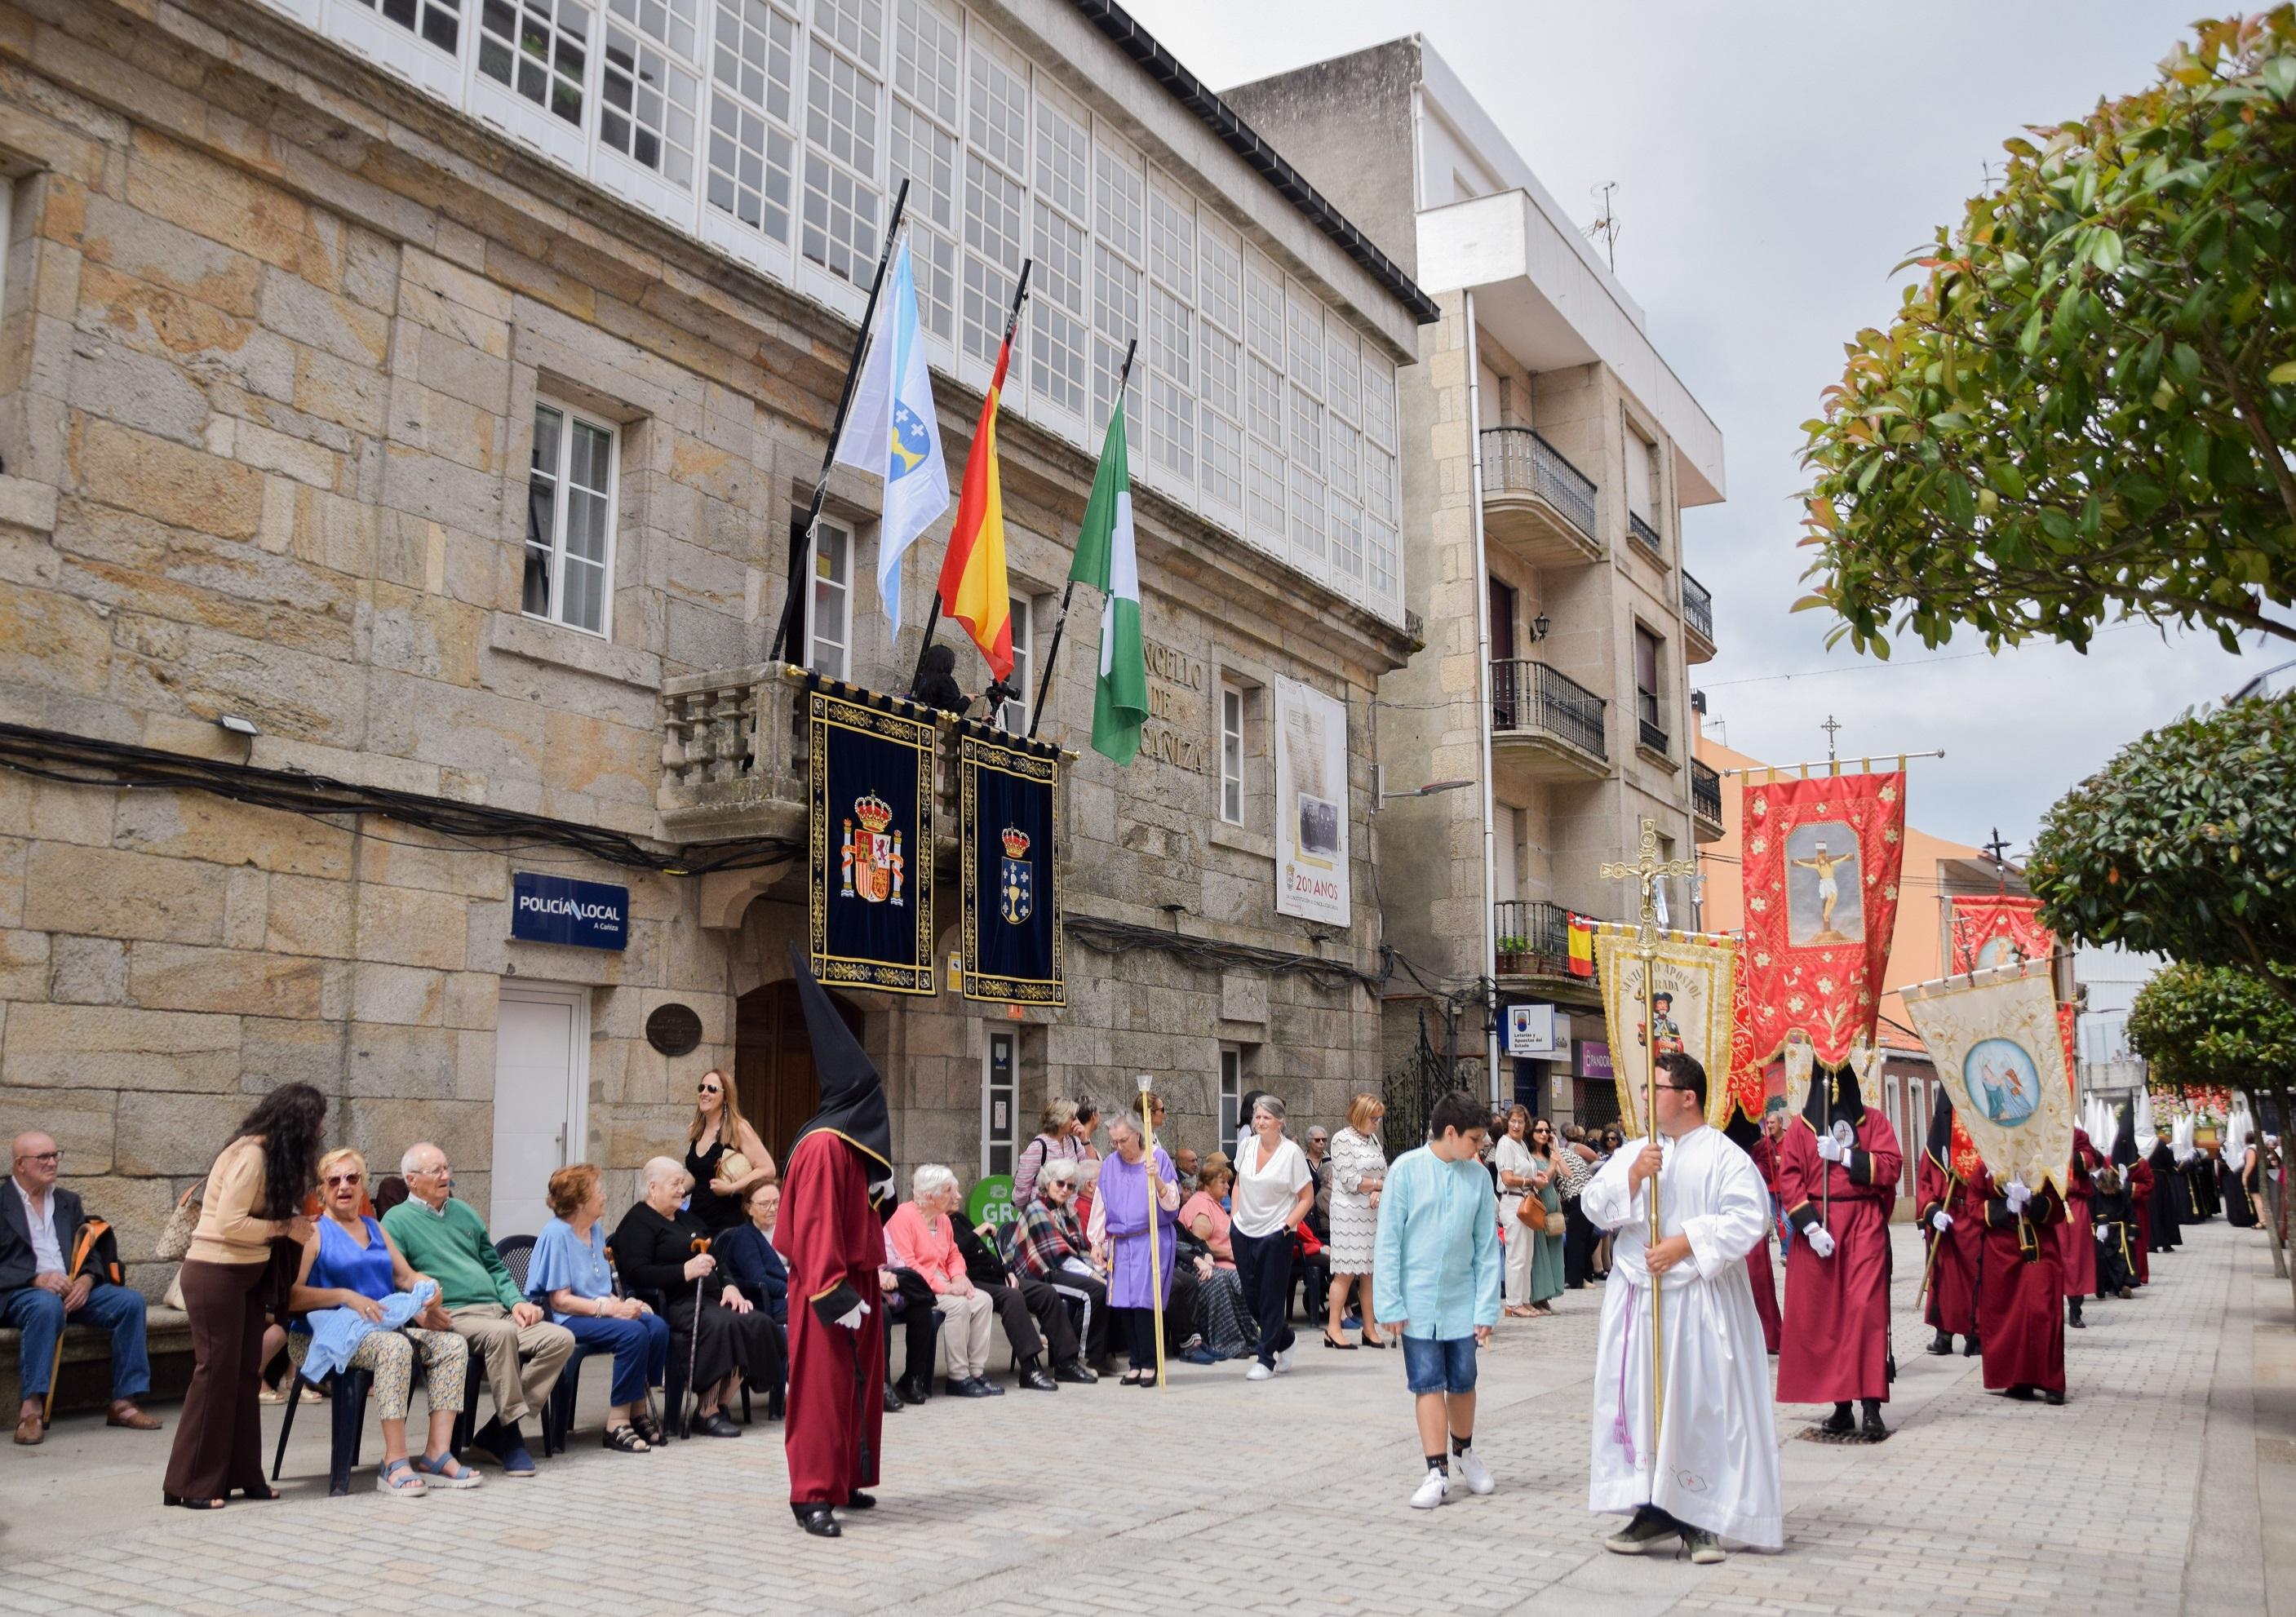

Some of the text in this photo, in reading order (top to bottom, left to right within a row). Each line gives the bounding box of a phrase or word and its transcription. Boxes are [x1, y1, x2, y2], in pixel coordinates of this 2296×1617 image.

[1143, 643, 1201, 690] NCELLO
[1150, 686, 1171, 720] DE
[1296, 875, 1338, 901] 200 ANOS
[520, 896, 620, 921] POLICÍA LOCAL
[600, 923, 619, 932] Cañiza
